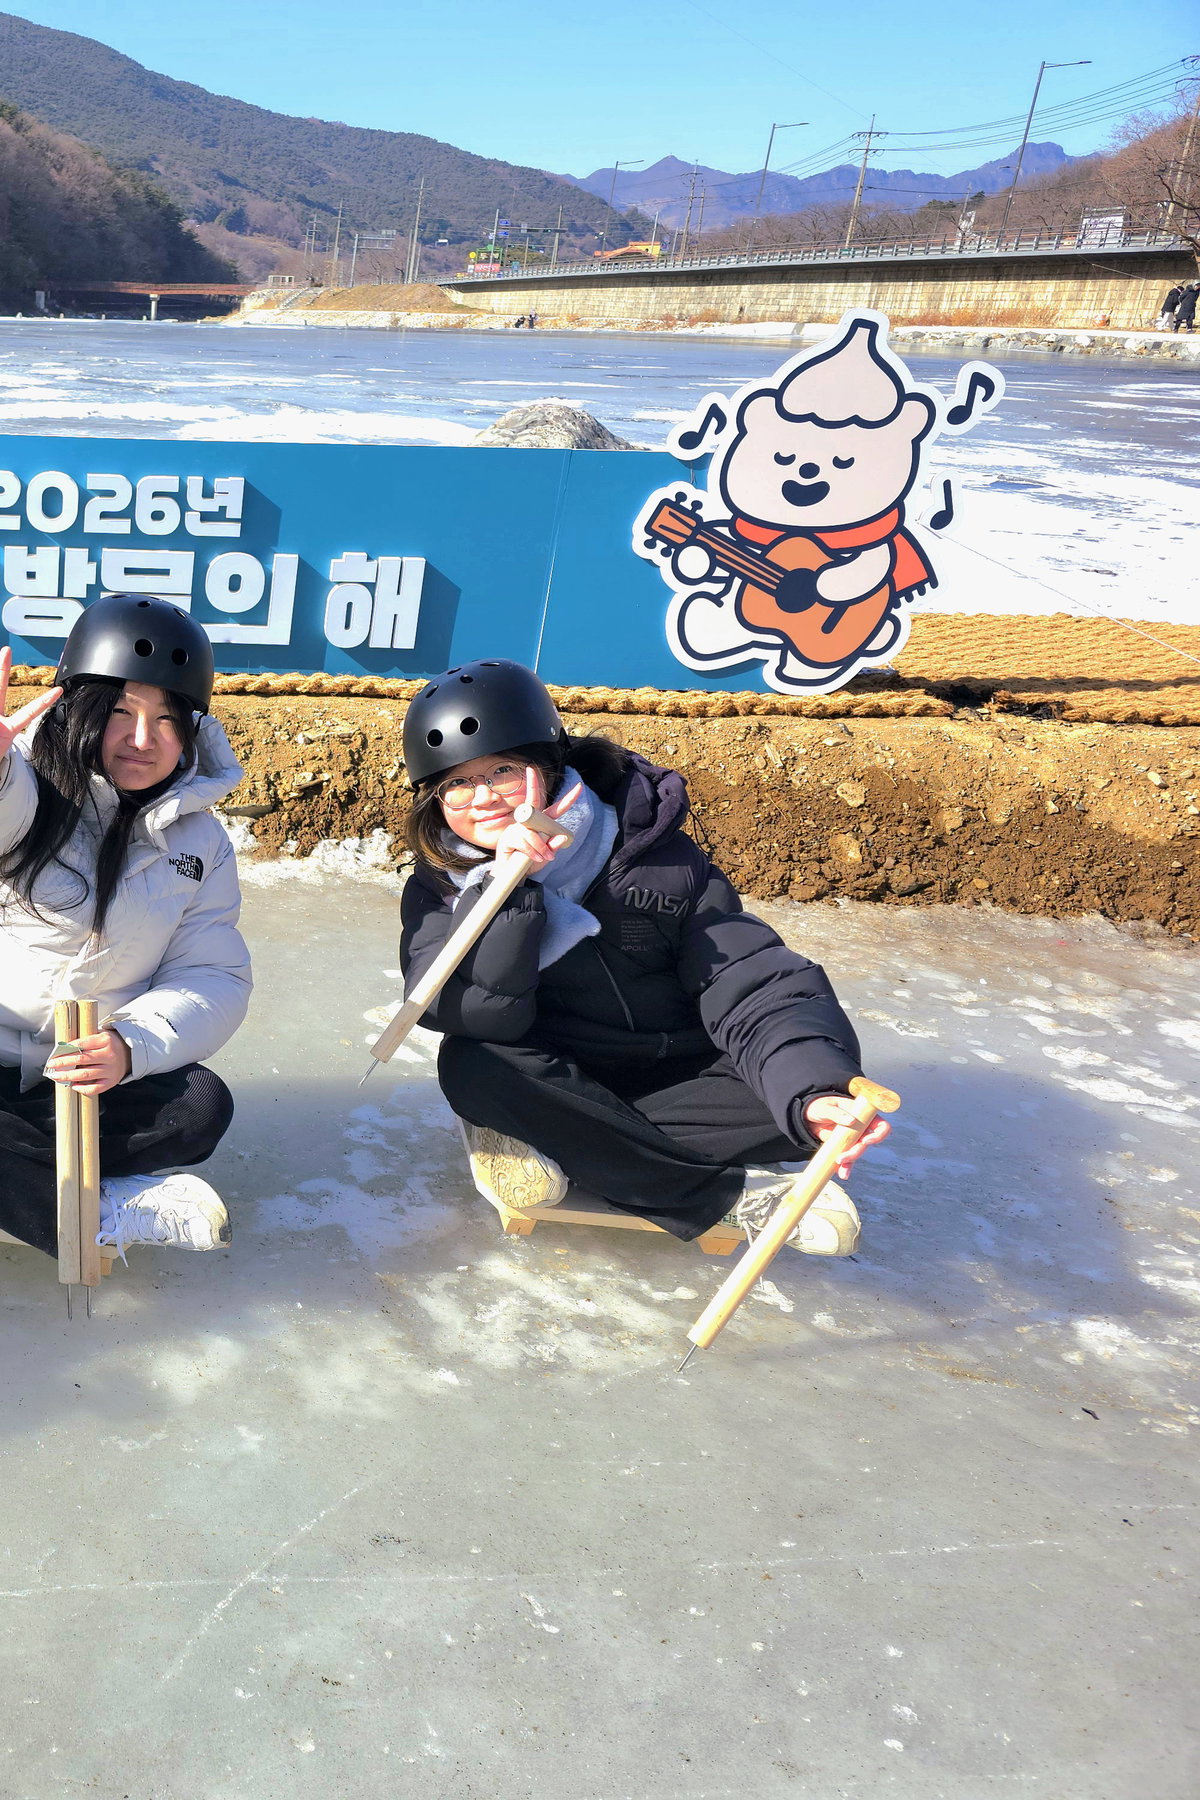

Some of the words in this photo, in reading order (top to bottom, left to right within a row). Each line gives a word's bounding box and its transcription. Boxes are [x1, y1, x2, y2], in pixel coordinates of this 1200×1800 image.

[323, 551, 426, 649] 해
[168, 858, 196, 871] NORTH
[180, 853, 196, 863] THE
[177, 867, 194, 879] FACE
[624, 886, 689, 917] NASA
